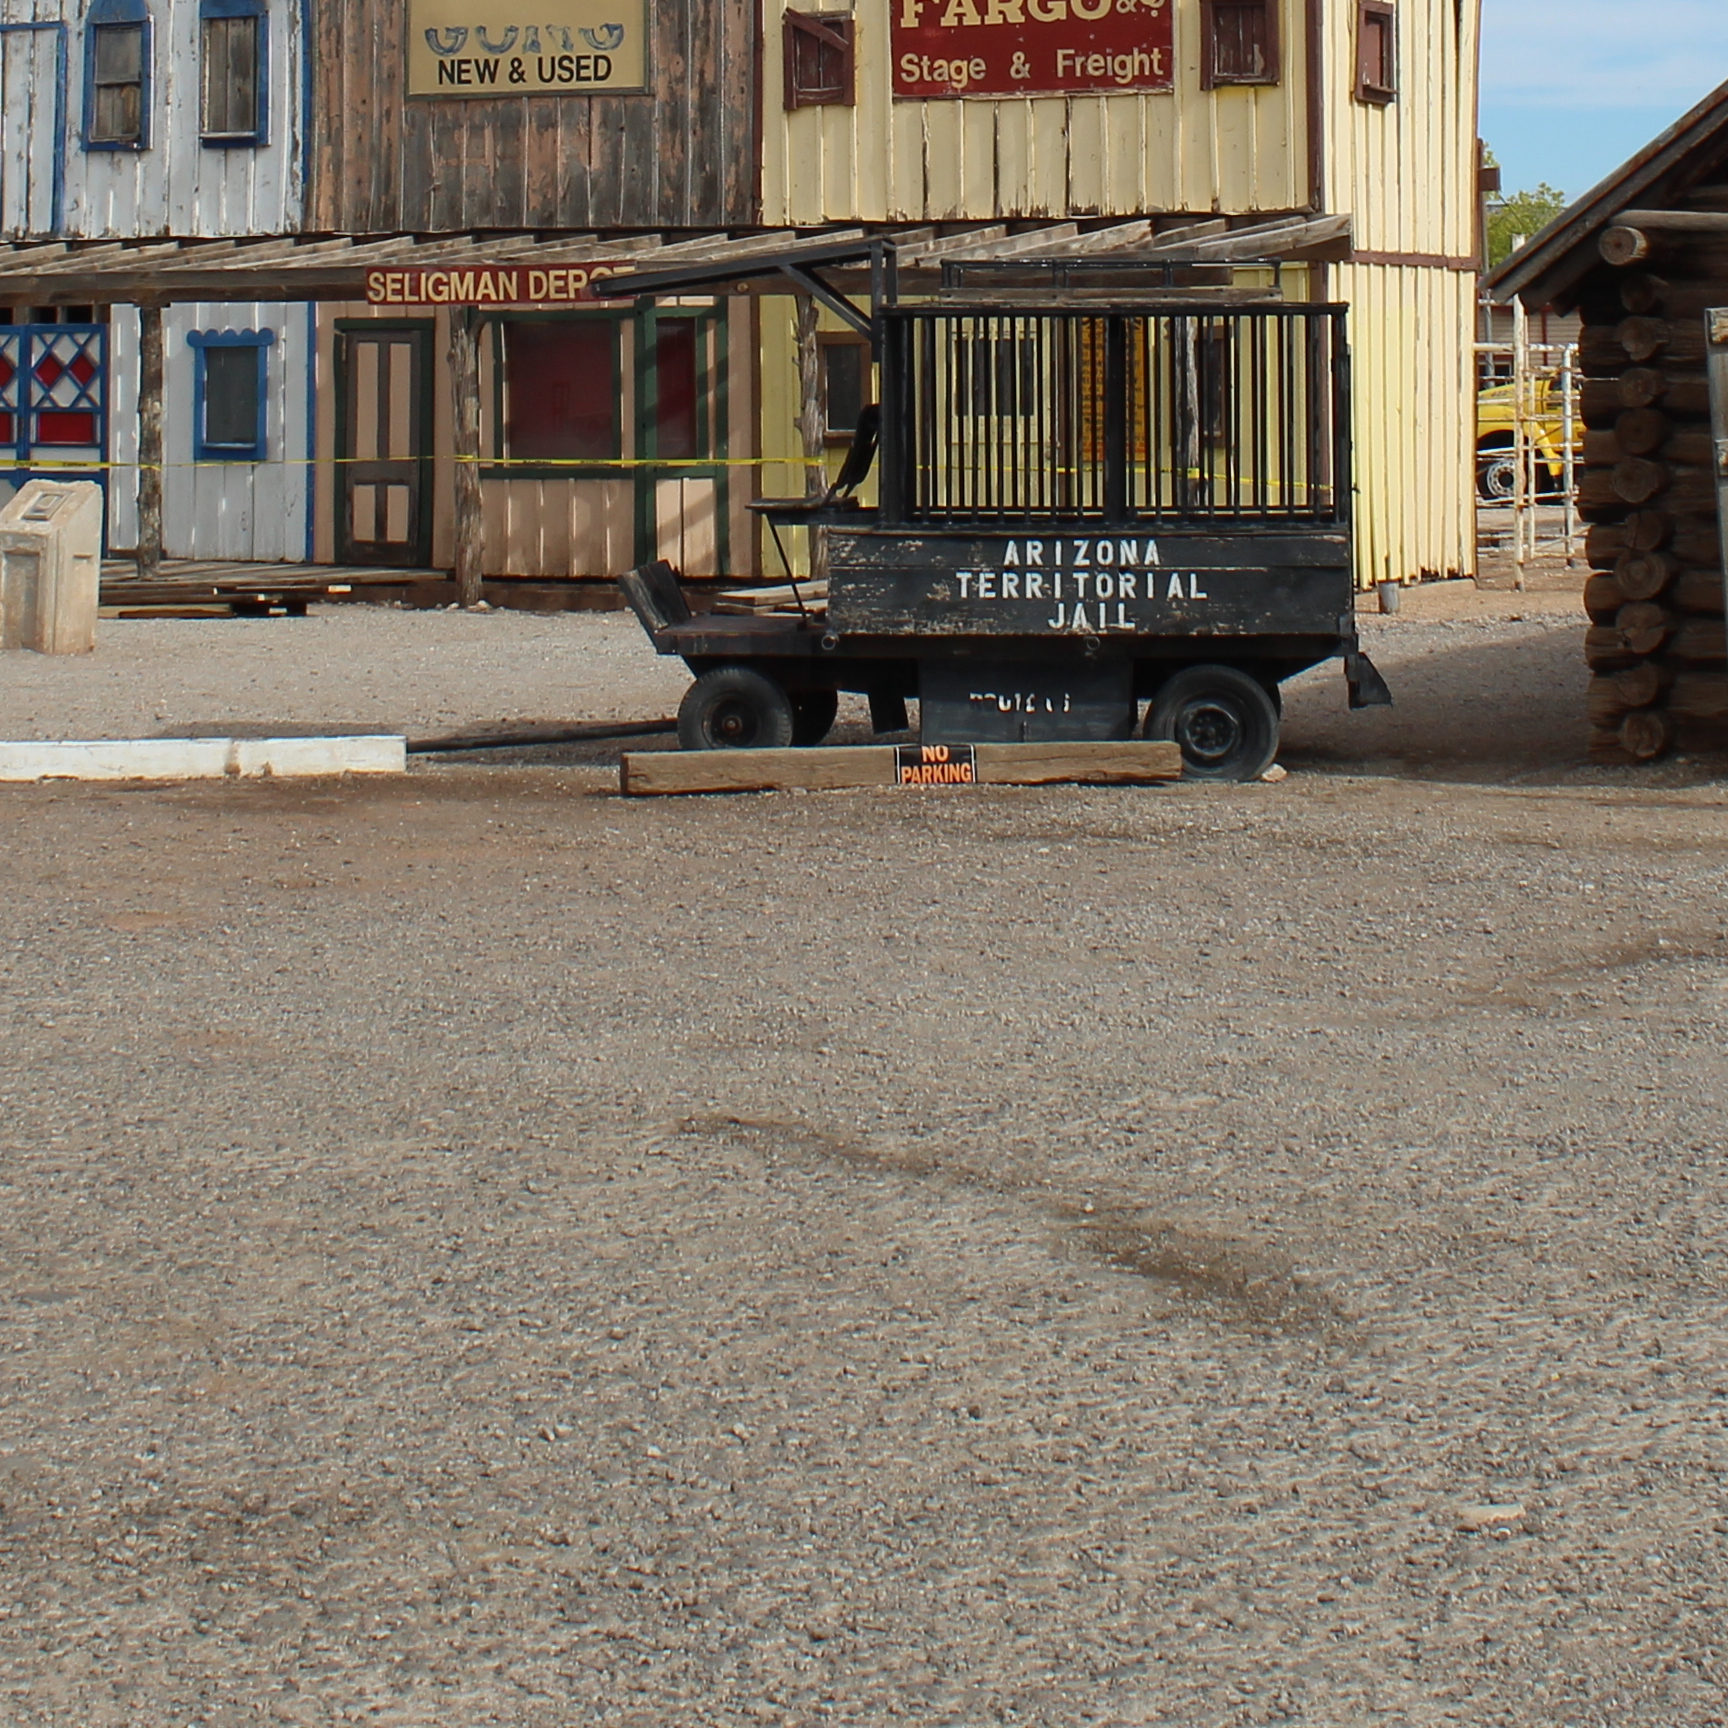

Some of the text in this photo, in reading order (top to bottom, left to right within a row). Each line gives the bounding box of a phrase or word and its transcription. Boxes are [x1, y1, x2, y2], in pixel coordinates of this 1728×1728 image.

[438, 54, 612, 85] NEW & USED
[900, 47, 1164, 89] Stage & Freight
[367, 265, 635, 302] SELIGMAN DEP
[1003, 539, 1161, 567] ARIZONA
[955, 571, 1208, 600] TERRITORIAL
[1046, 601, 1137, 632] JAIL
[921, 745, 950, 763] NO
[900, 762, 973, 784] PARKING
